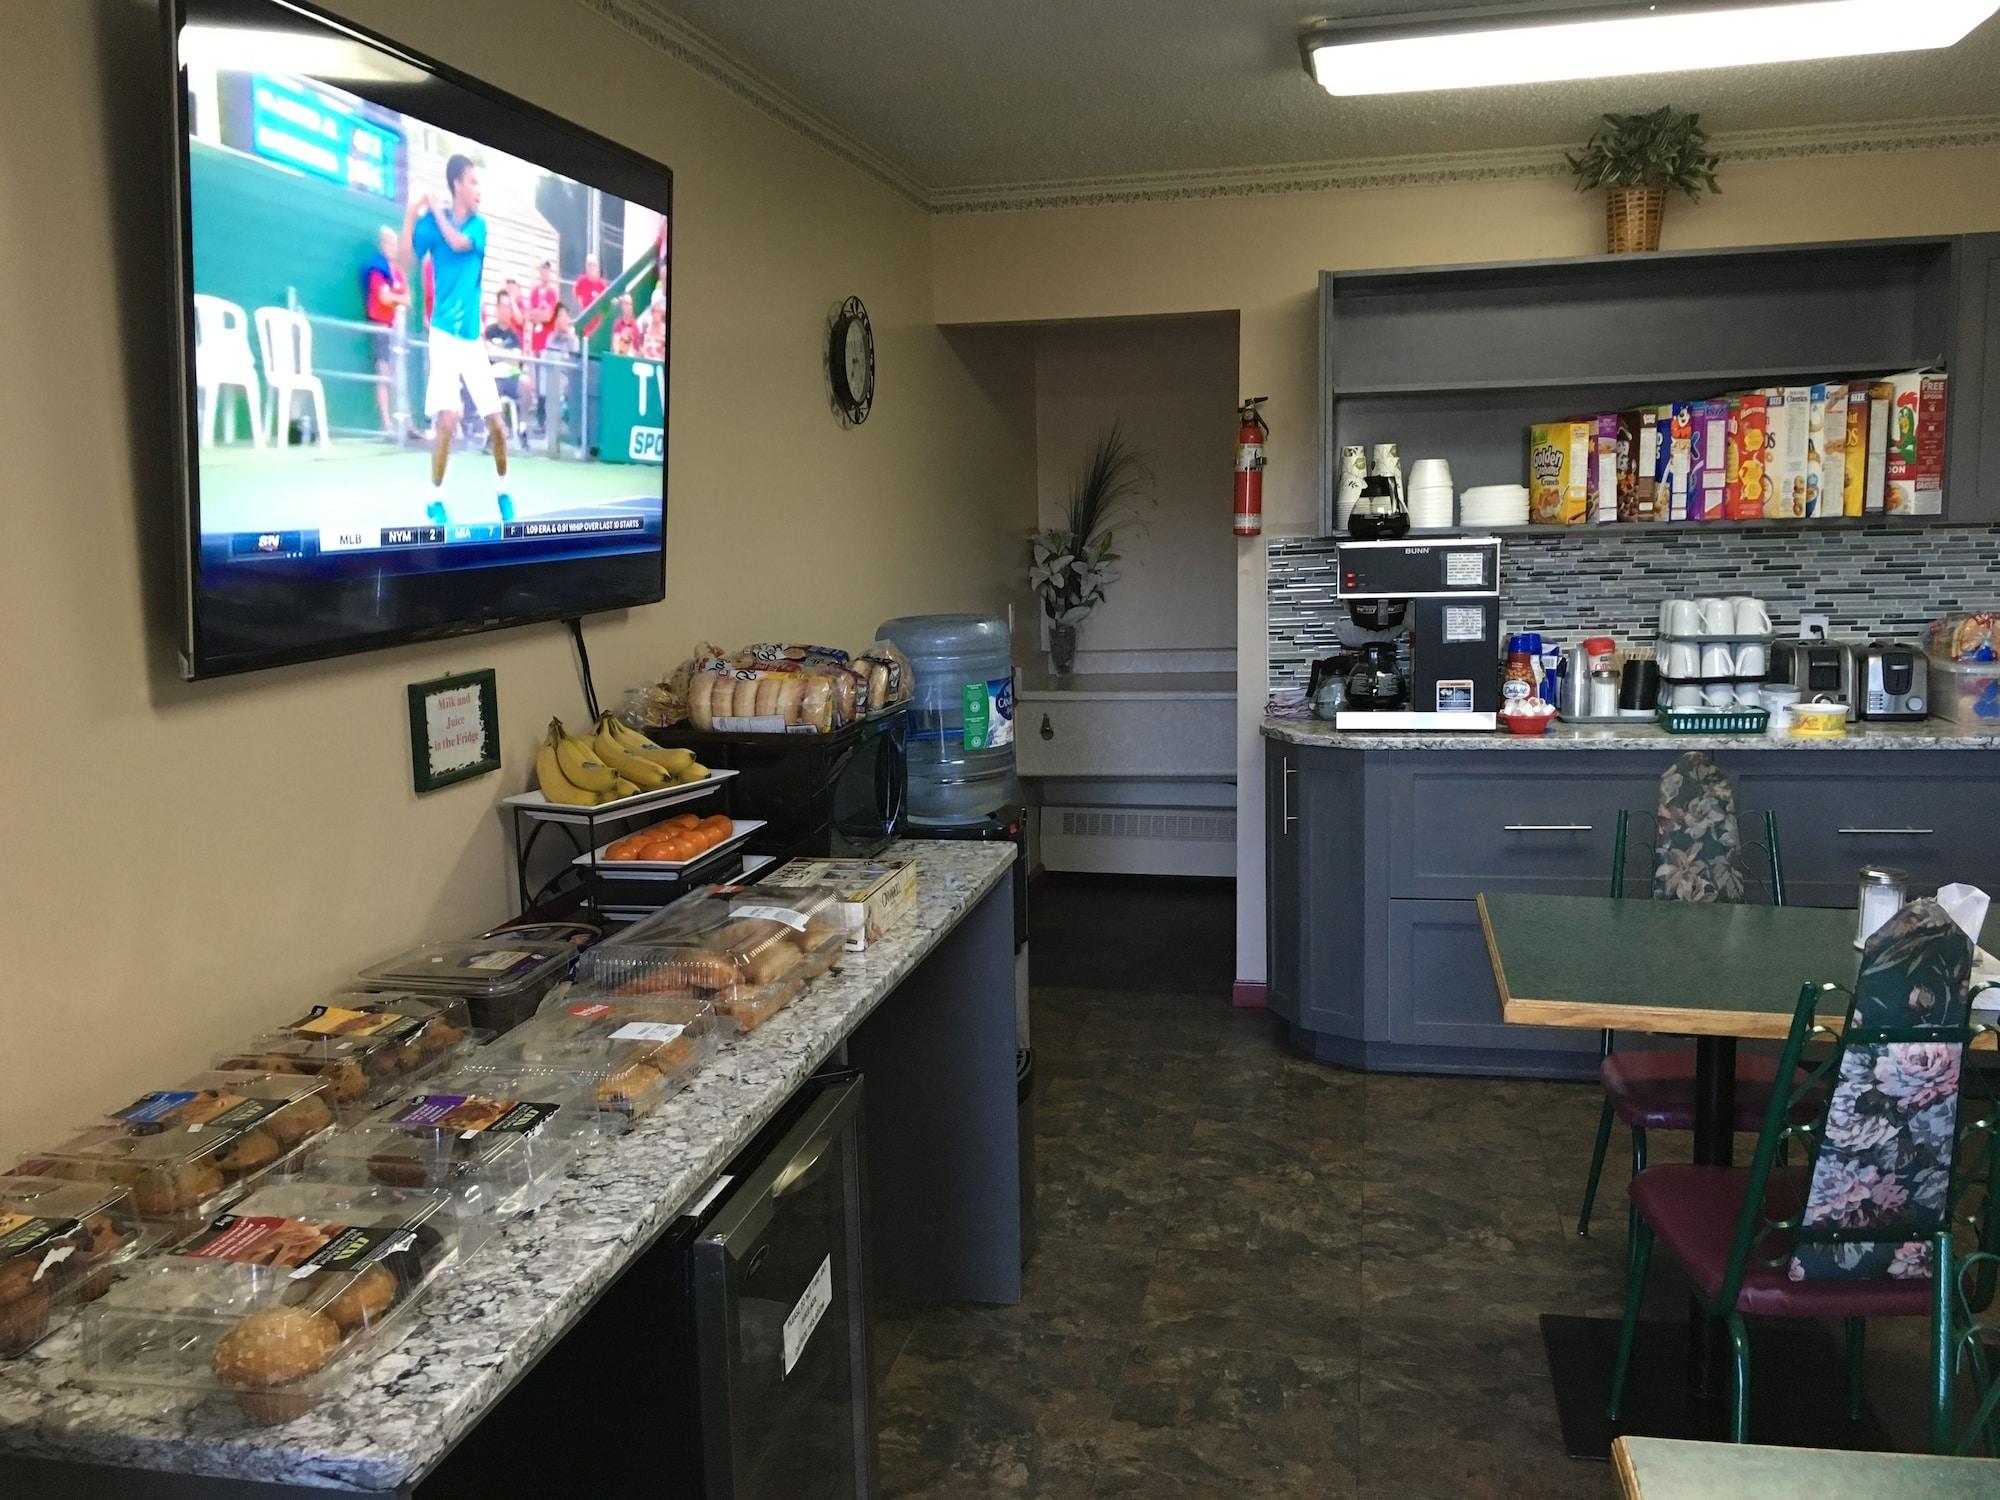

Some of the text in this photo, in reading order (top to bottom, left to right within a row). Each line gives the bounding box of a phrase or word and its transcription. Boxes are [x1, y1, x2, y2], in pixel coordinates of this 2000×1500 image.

[1921, 381, 1944, 391] FREE
[634, 432, 664, 456] SPO
[1533, 445, 1564, 467] Golden
[339, 534, 362, 545] MLB
[388, 531, 412, 543] NYM
[429, 529, 436, 541] 2
[455, 526, 471, 539] MIA
[488, 525, 494, 537] 7
[510, 526, 516, 536] F
[539, 524, 551, 534] ERA
[557, 523, 569, 533] 0.91
[569, 522, 584, 532] WHIP
[584, 521, 599, 531] OVER
[600, 521, 613, 530] LAST
[614, 520, 620, 529] 10
[620, 519, 640, 529] STARTS
[438, 693, 471, 709] Milk and
[446, 716, 465, 730] Juice
[442, 735, 455, 749] the
[456, 731, 480, 746] Fridge
